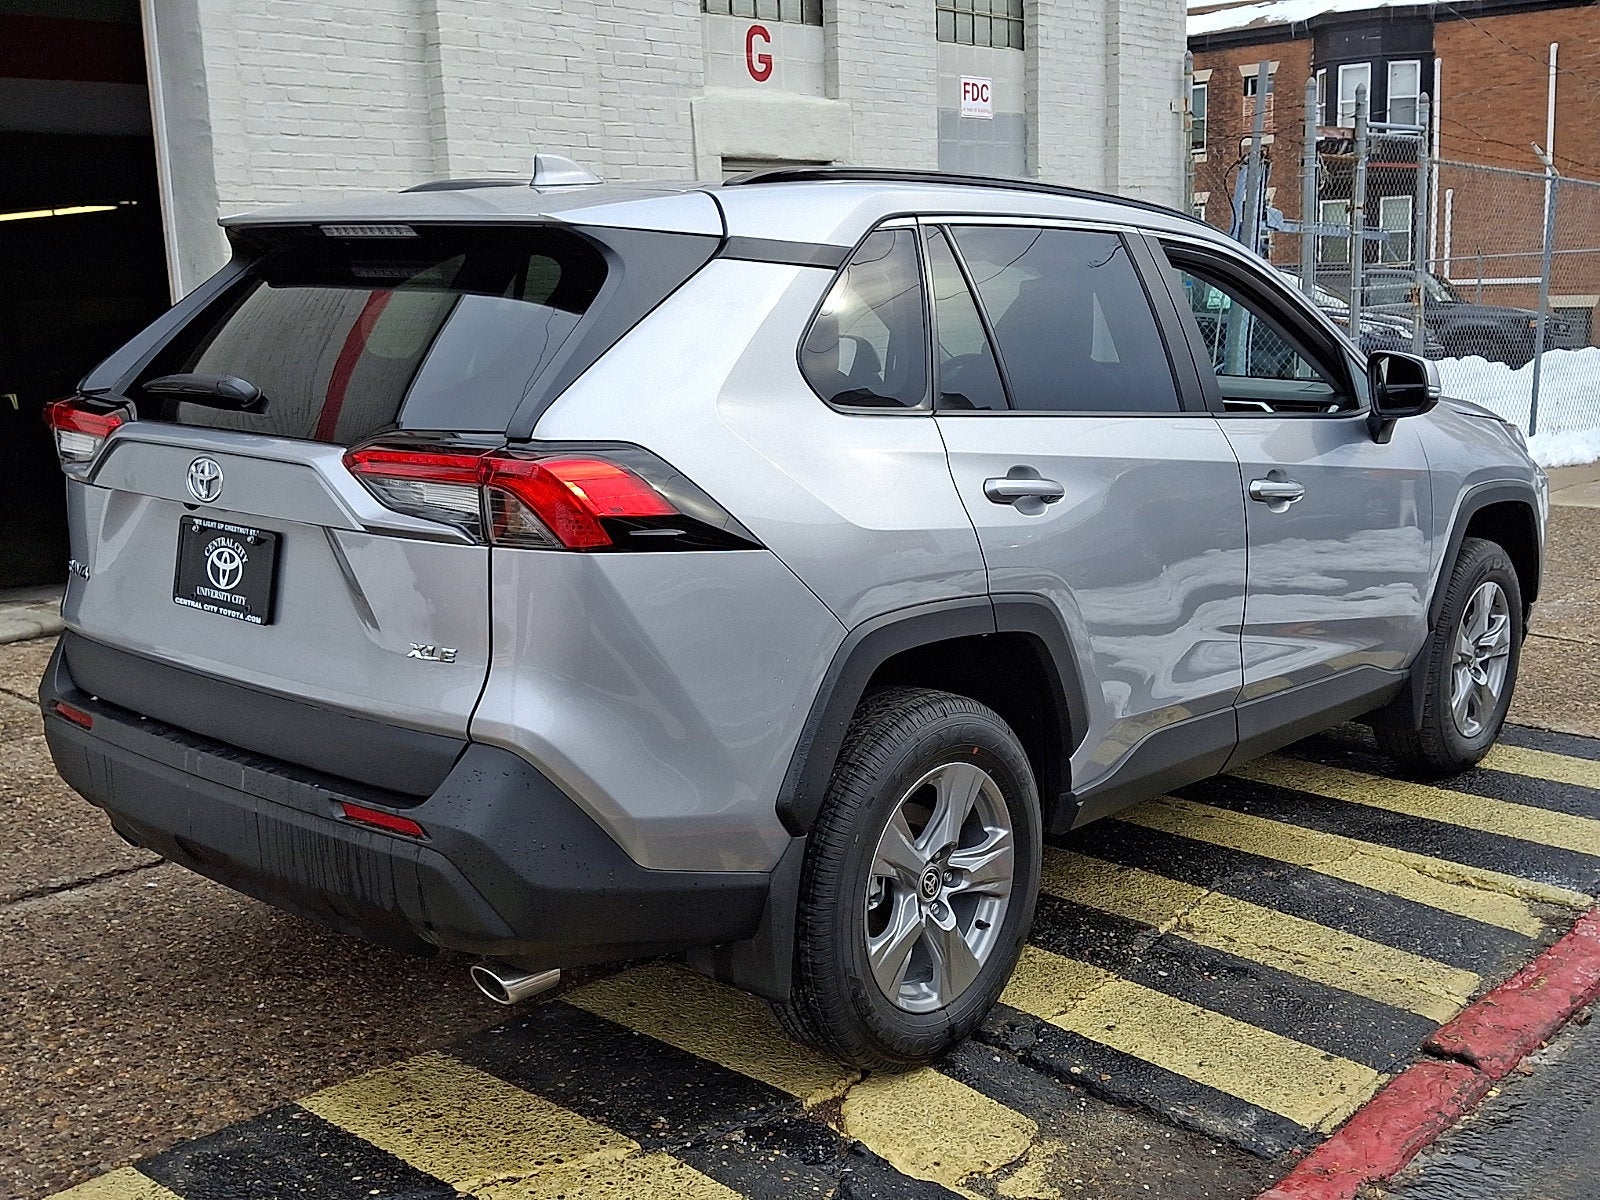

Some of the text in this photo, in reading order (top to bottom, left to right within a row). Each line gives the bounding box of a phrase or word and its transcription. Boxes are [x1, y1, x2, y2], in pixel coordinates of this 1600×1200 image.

[746, 24, 773, 82] G
[963, 82, 989, 103] FDC
[204, 536, 250, 564] CENTRAL CITY
[196, 585, 247, 606] UNIVERSITY CITY
[174, 597, 262, 625] CENTRAL CITY TOYOTA .COM
[406, 641, 458, 664] XLE
